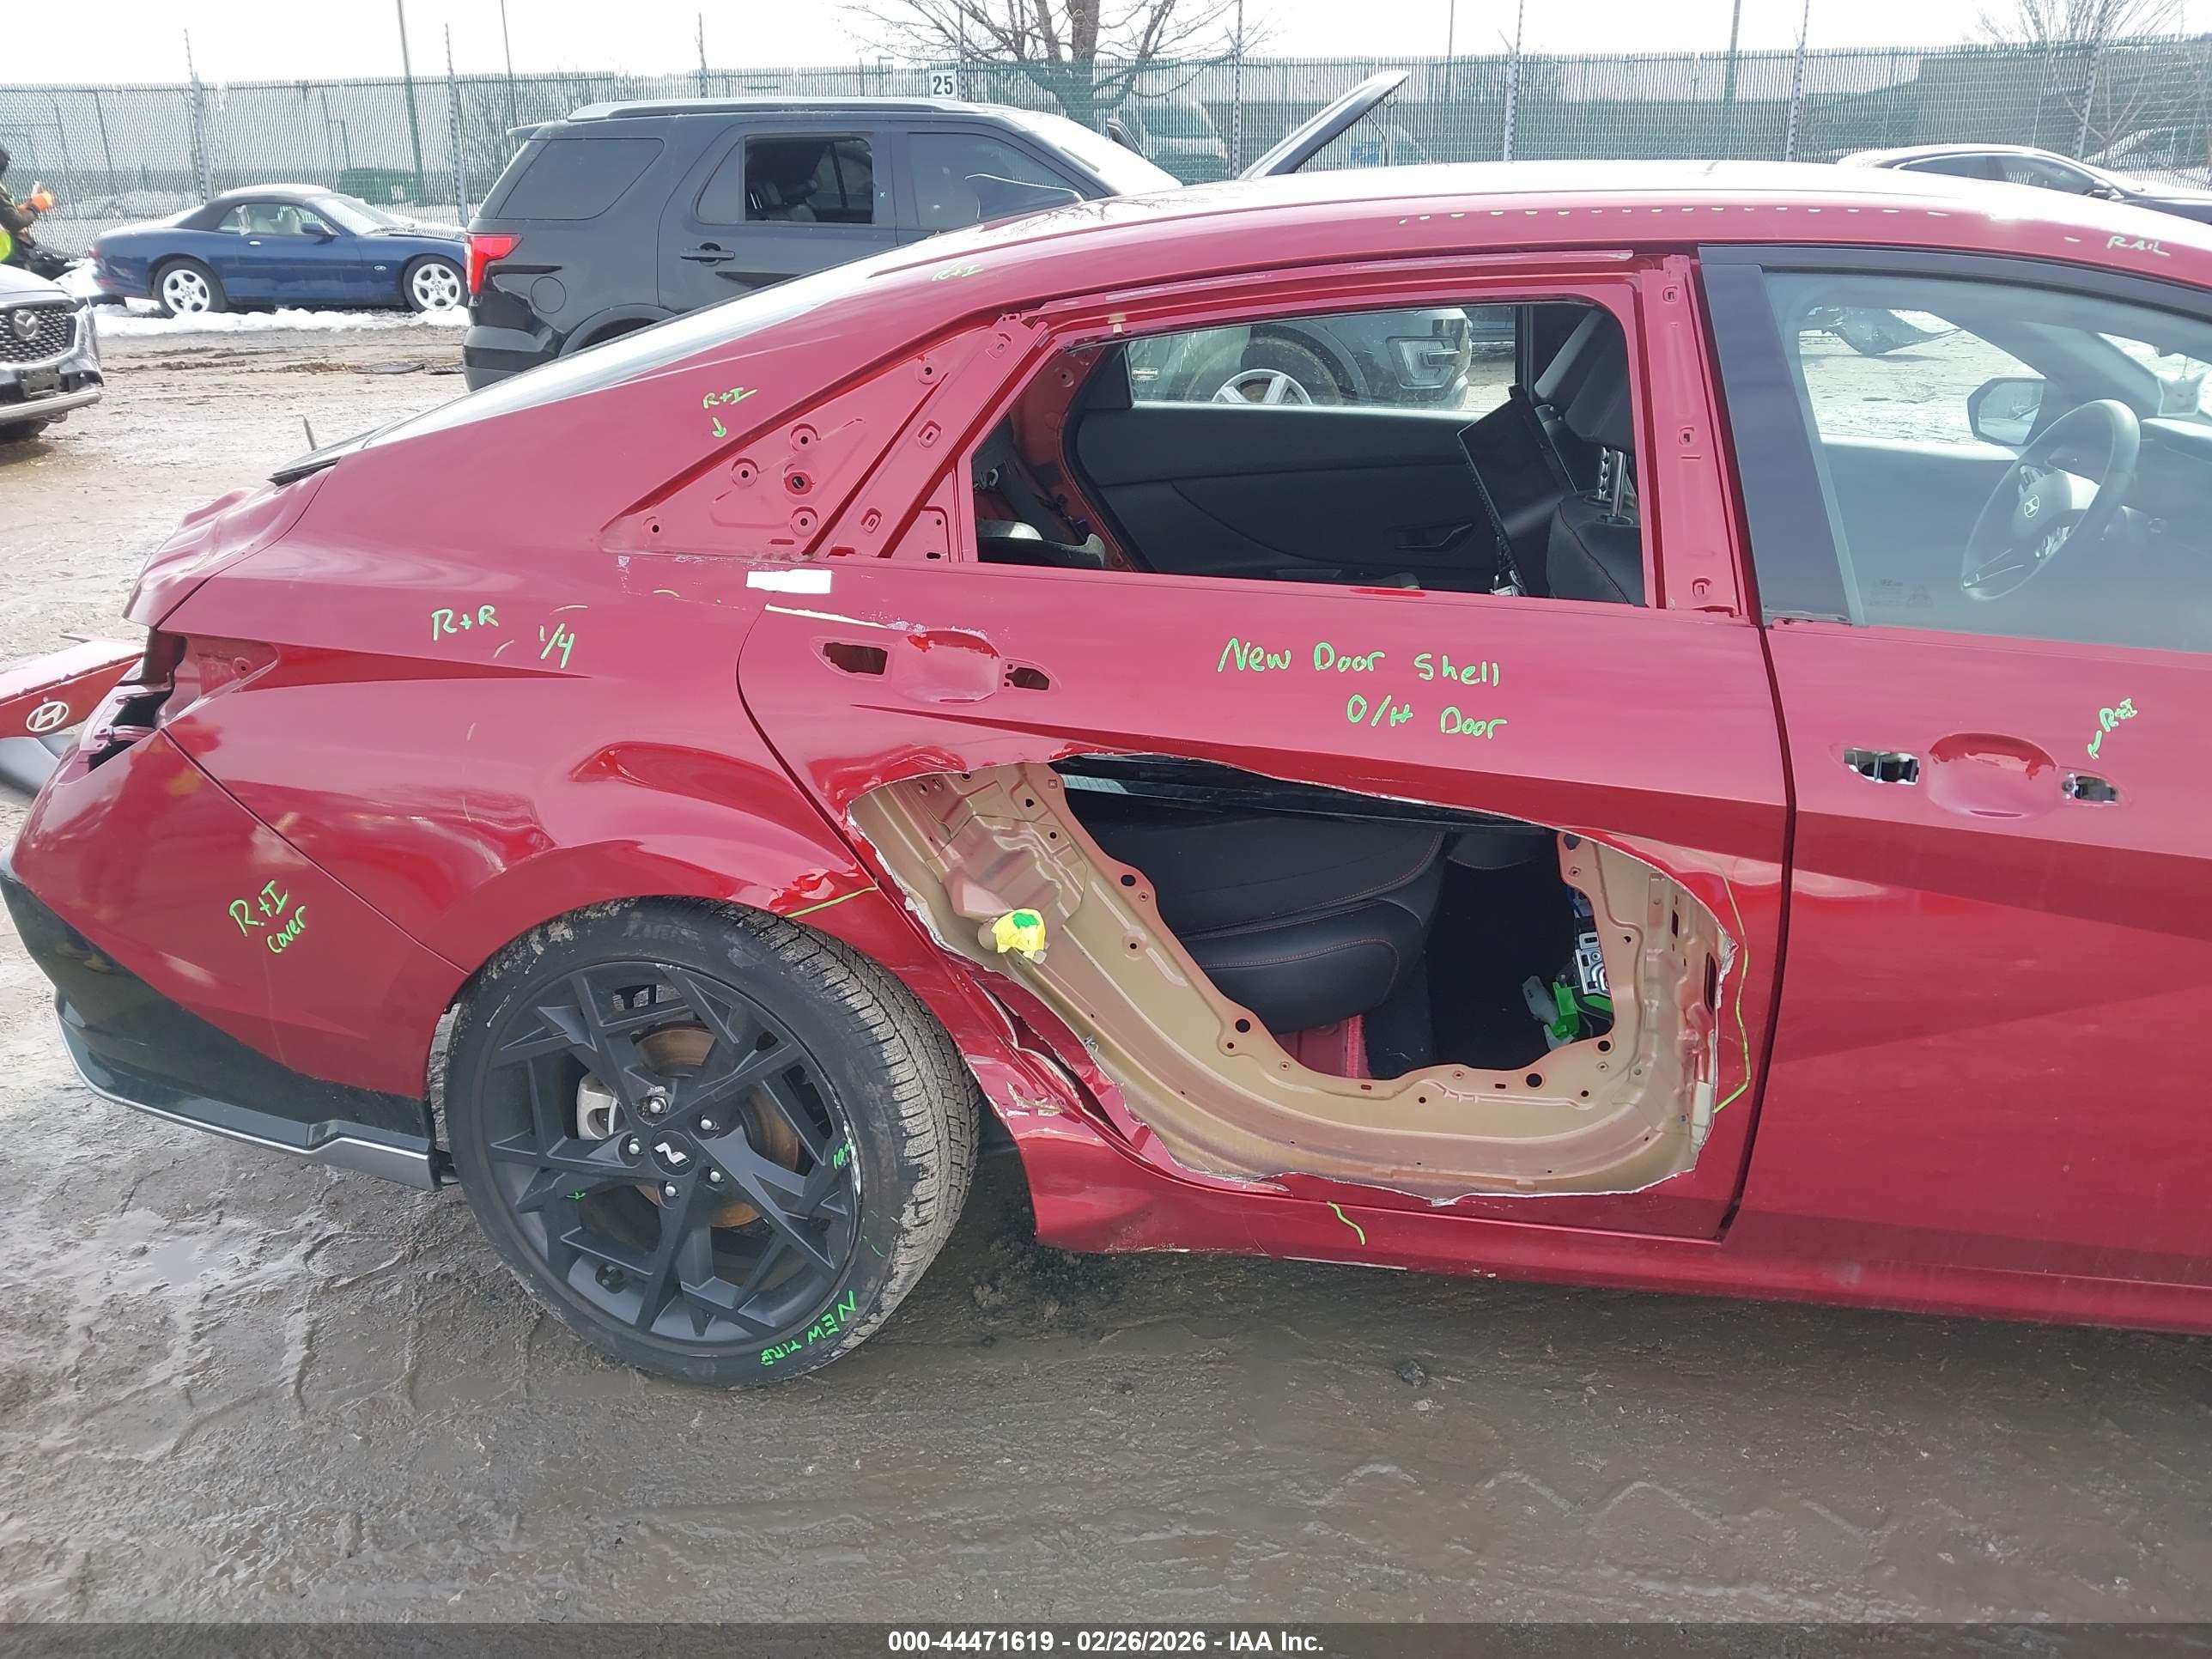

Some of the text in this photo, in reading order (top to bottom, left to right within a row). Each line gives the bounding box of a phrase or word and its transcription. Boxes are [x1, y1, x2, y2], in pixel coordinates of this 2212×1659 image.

[933, 75, 954, 95] 25
[431, 605, 575, 669] R+R 1/4
[1216, 637, 1291, 672] New
[1313, 641, 1386, 673] Door
[1346, 694, 1508, 740] O/H Door
[807, 1290, 857, 1346] NEW
